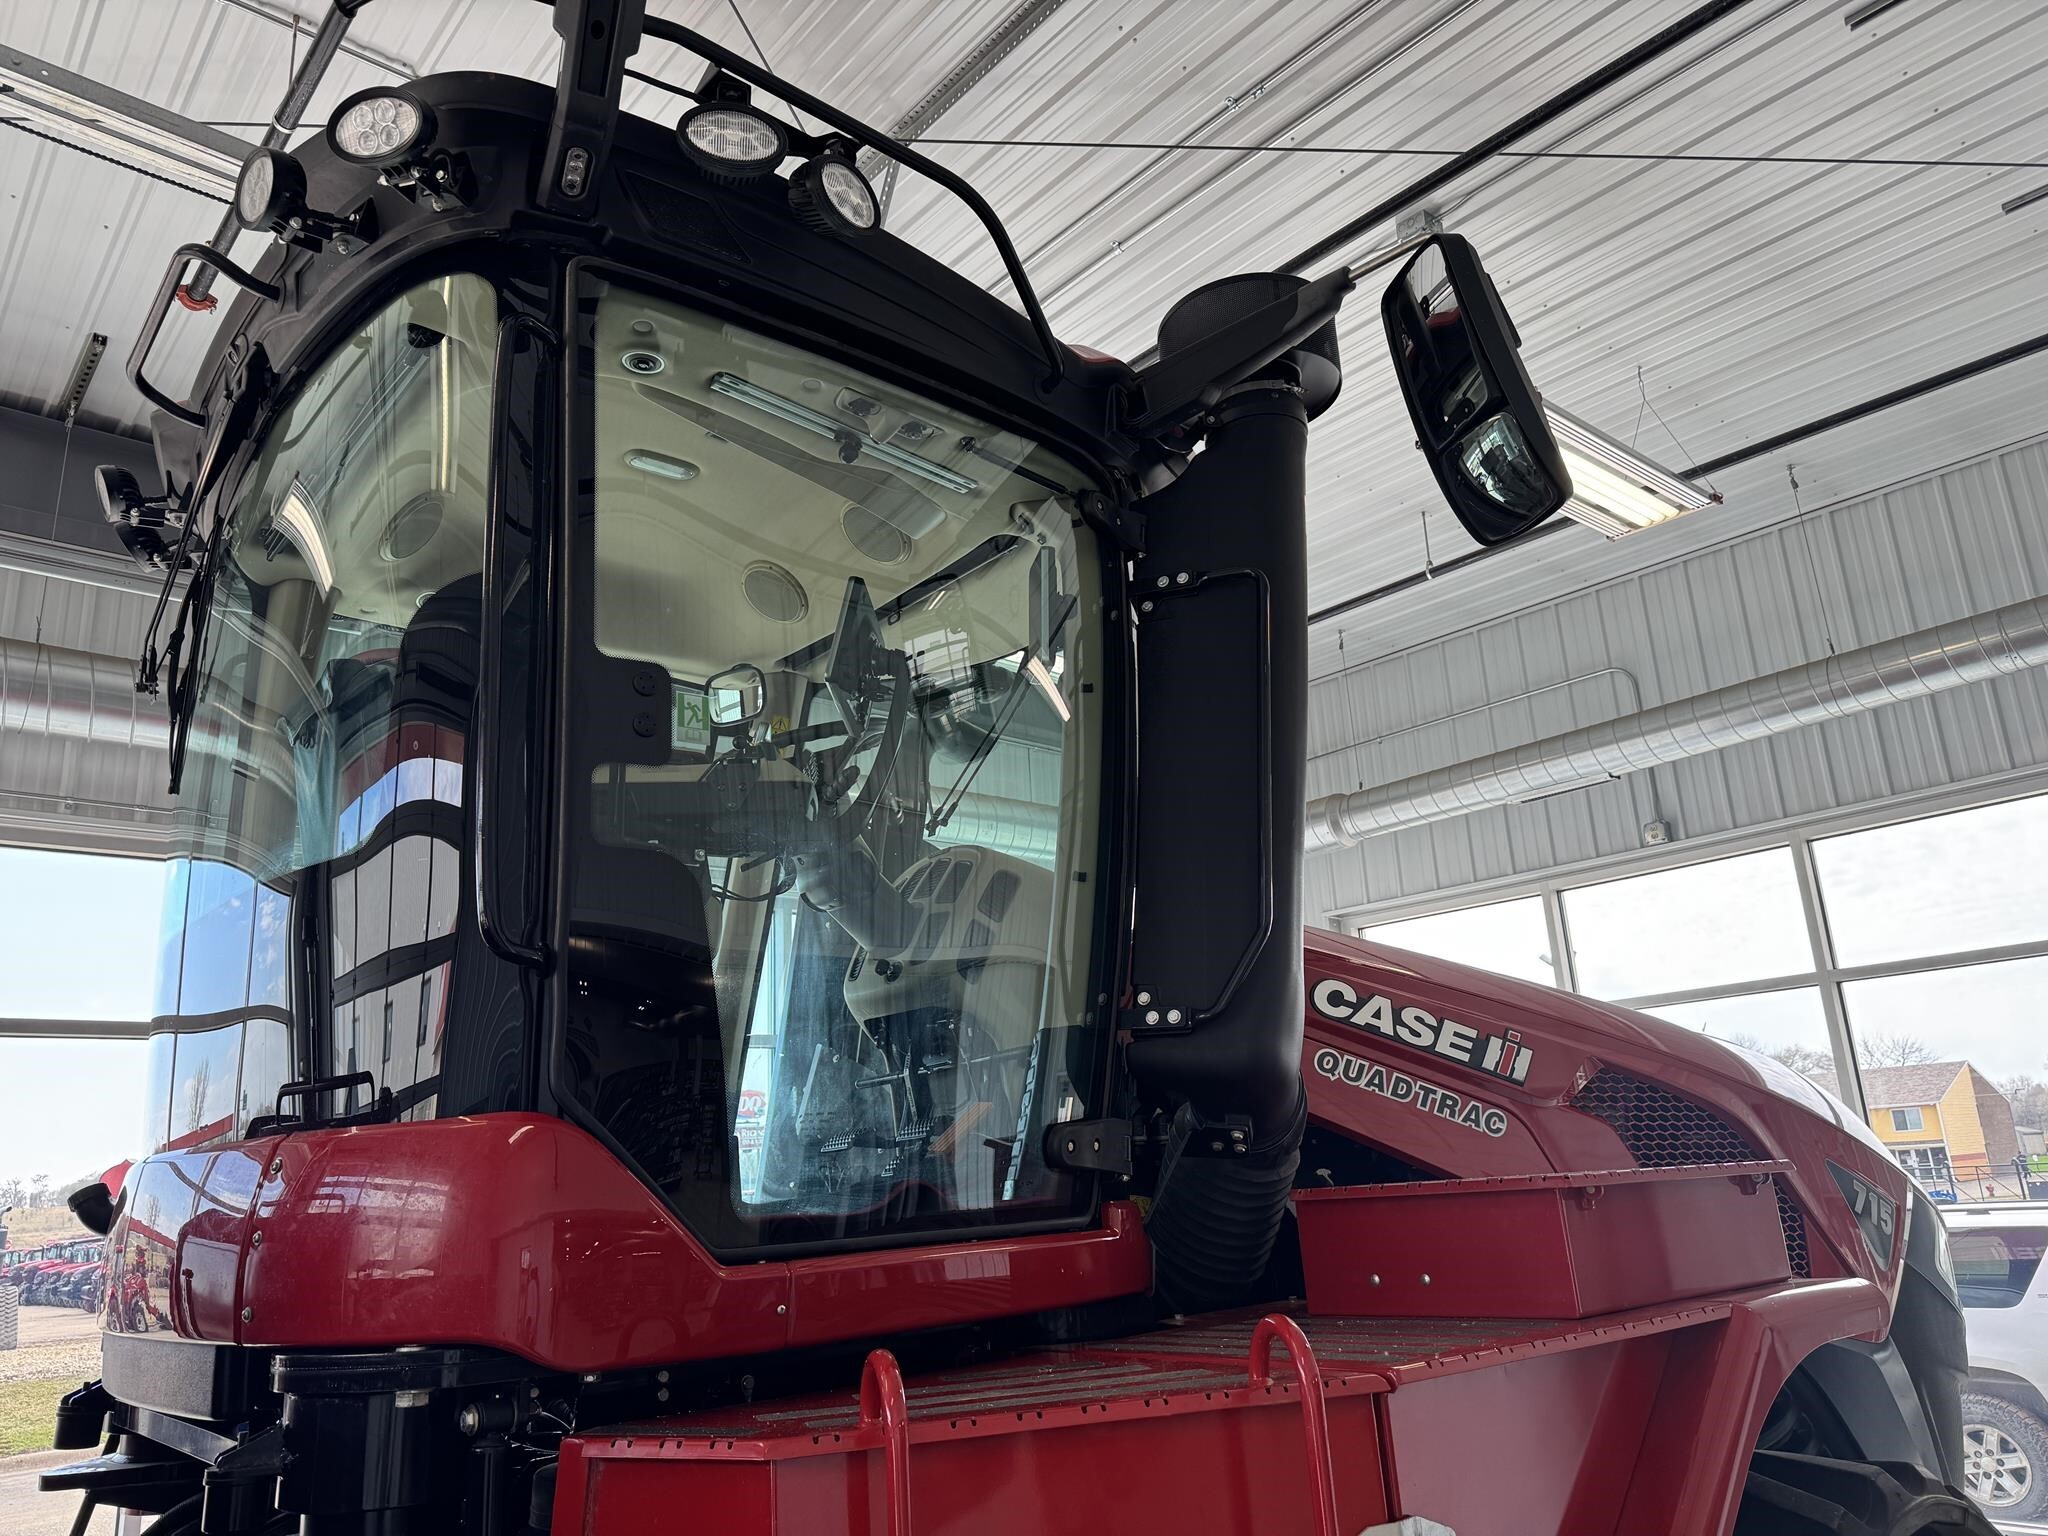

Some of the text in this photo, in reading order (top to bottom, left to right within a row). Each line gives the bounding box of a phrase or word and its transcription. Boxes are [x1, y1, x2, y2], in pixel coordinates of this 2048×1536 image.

[1312, 979, 1479, 1063] CASE
[1313, 1048, 1508, 1138] QUADTRAC
[1853, 1179, 1892, 1236] 715
